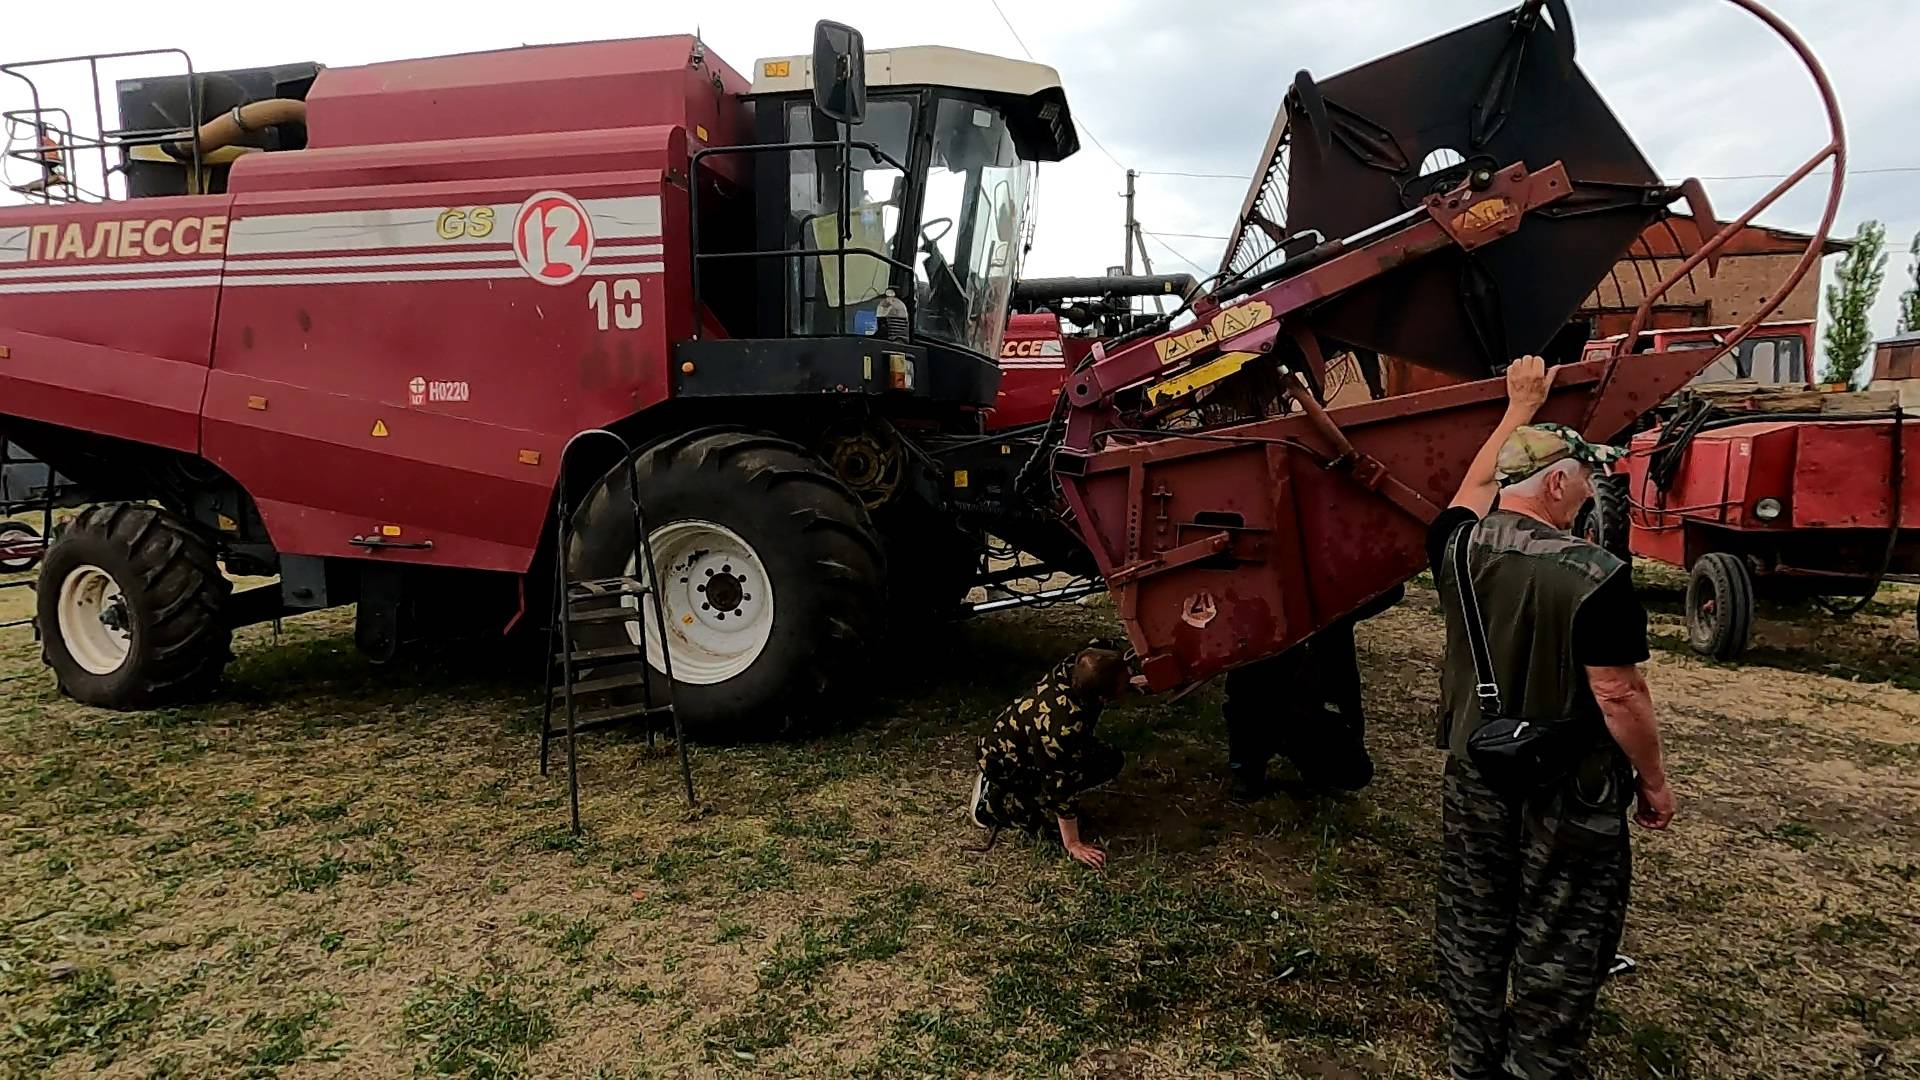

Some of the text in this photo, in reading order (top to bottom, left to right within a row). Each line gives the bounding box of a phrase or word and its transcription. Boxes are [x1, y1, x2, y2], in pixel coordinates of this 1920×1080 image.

[29, 215, 228, 261] ПАЛЕССЕ
[436, 204, 584, 278] GS 12
[588, 278, 643, 330] 10
